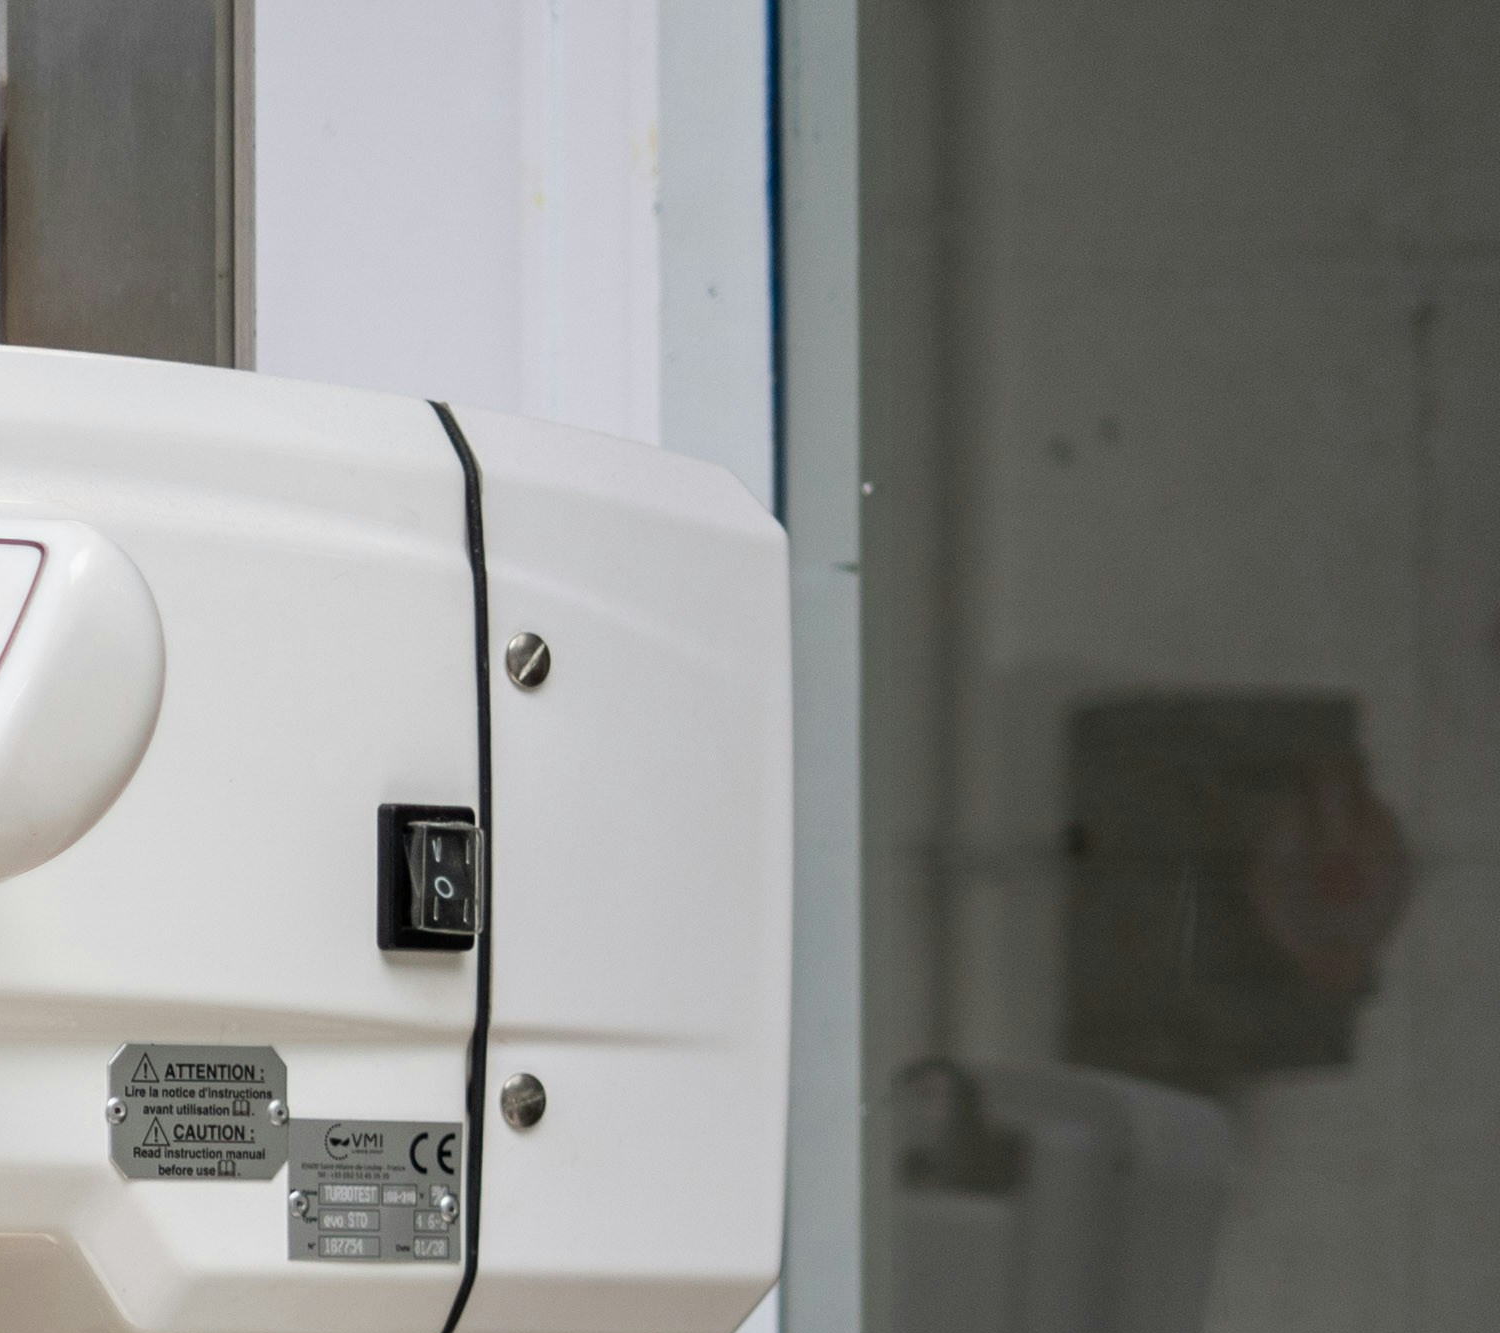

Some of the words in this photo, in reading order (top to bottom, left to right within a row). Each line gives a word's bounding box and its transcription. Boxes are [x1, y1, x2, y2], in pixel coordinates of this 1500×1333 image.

[164, 1063, 255, 1081] ATTENTION
[125, 1086, 146, 1098] Lire
[150, 1087, 159, 1098] la
[162, 1087, 195, 1098] notice
[199, 1087, 273, 1100] d'instructions
[143, 1104, 173, 1115] avant
[176, 1104, 230, 1116] utilisation
[173, 1124, 246, 1141] CAUTION
[351, 1132, 383, 1148] VMI
[133, 1147, 161, 1159] Read
[164, 1147, 222, 1159] instruction
[226, 1148, 266, 1160] manual
[158, 1164, 193, 1176] before
[196, 1167, 216, 1176] use
[324, 1184, 378, 1202] TURBOTEST
[323, 1214, 344, 1228] evo
